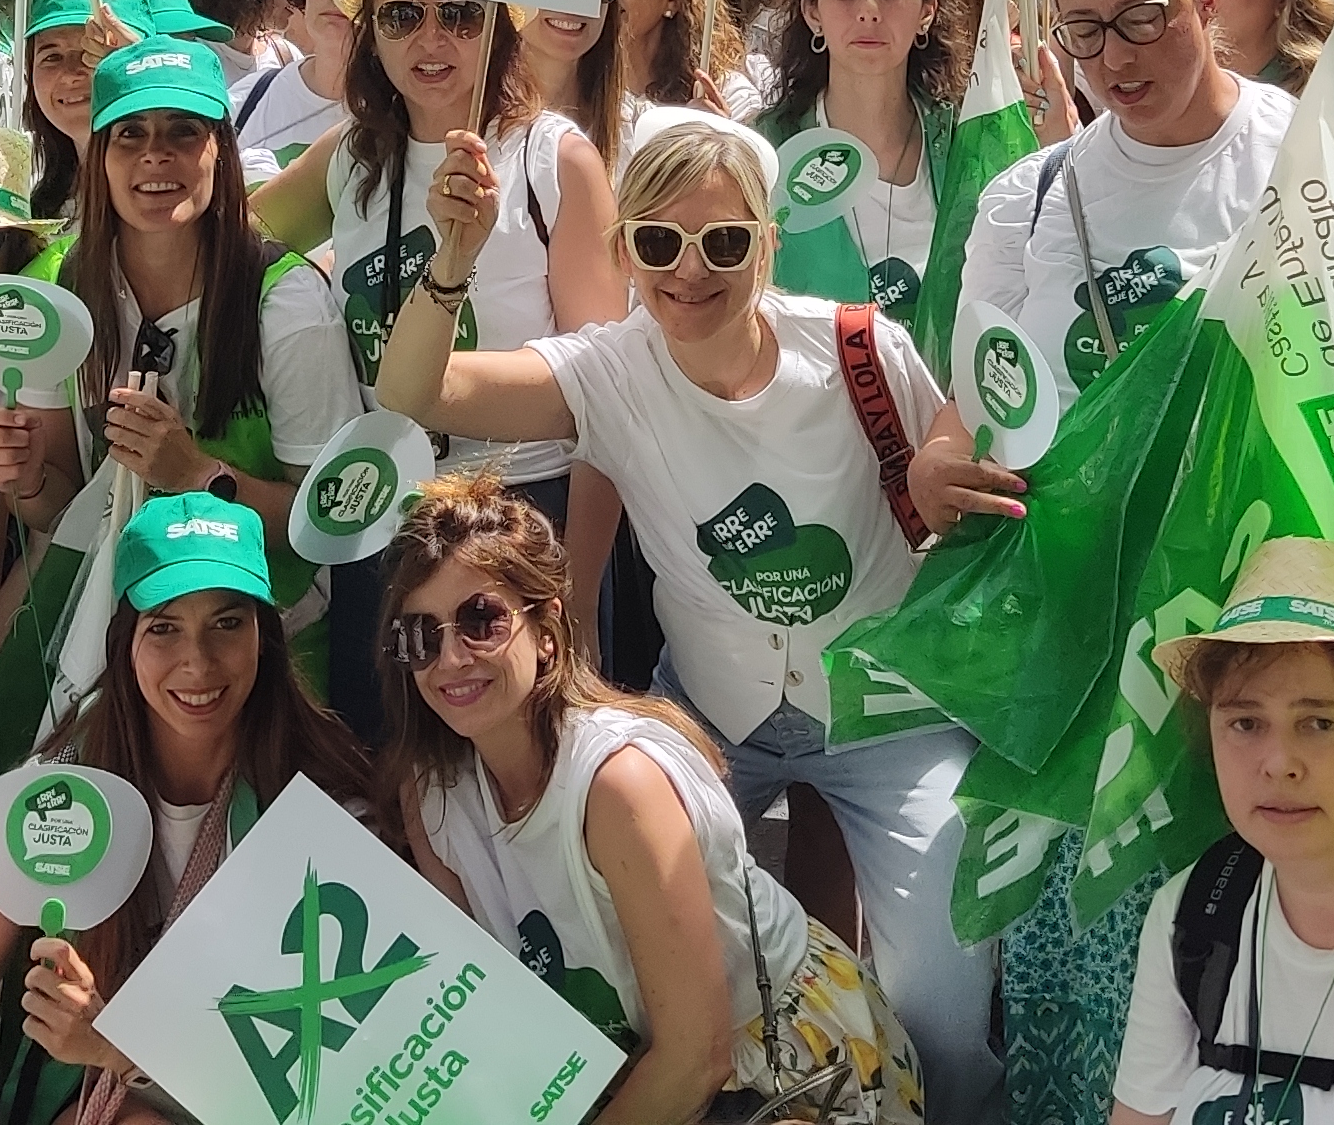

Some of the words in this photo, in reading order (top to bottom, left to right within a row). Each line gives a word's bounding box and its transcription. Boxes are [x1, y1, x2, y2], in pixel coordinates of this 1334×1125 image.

[126, 53, 191, 75] SATSE
[1105, 260, 1142, 295] ERRE
[1107, 291, 1127, 305] QUE
[1128, 263, 1167, 303] ERRE
[989, 371, 1012, 399] JUSTA
[350, 482, 372, 515] JUSTA
[167, 521, 239, 542] SATSE
[735, 512, 778, 554] ERRE
[756, 572, 782, 582] POR
[784, 567, 811, 581] UNA
[33, 832, 72, 847] JUSTA
[219, 881, 421, 1125] A2
[530, 1050, 588, 1123] SATSE
